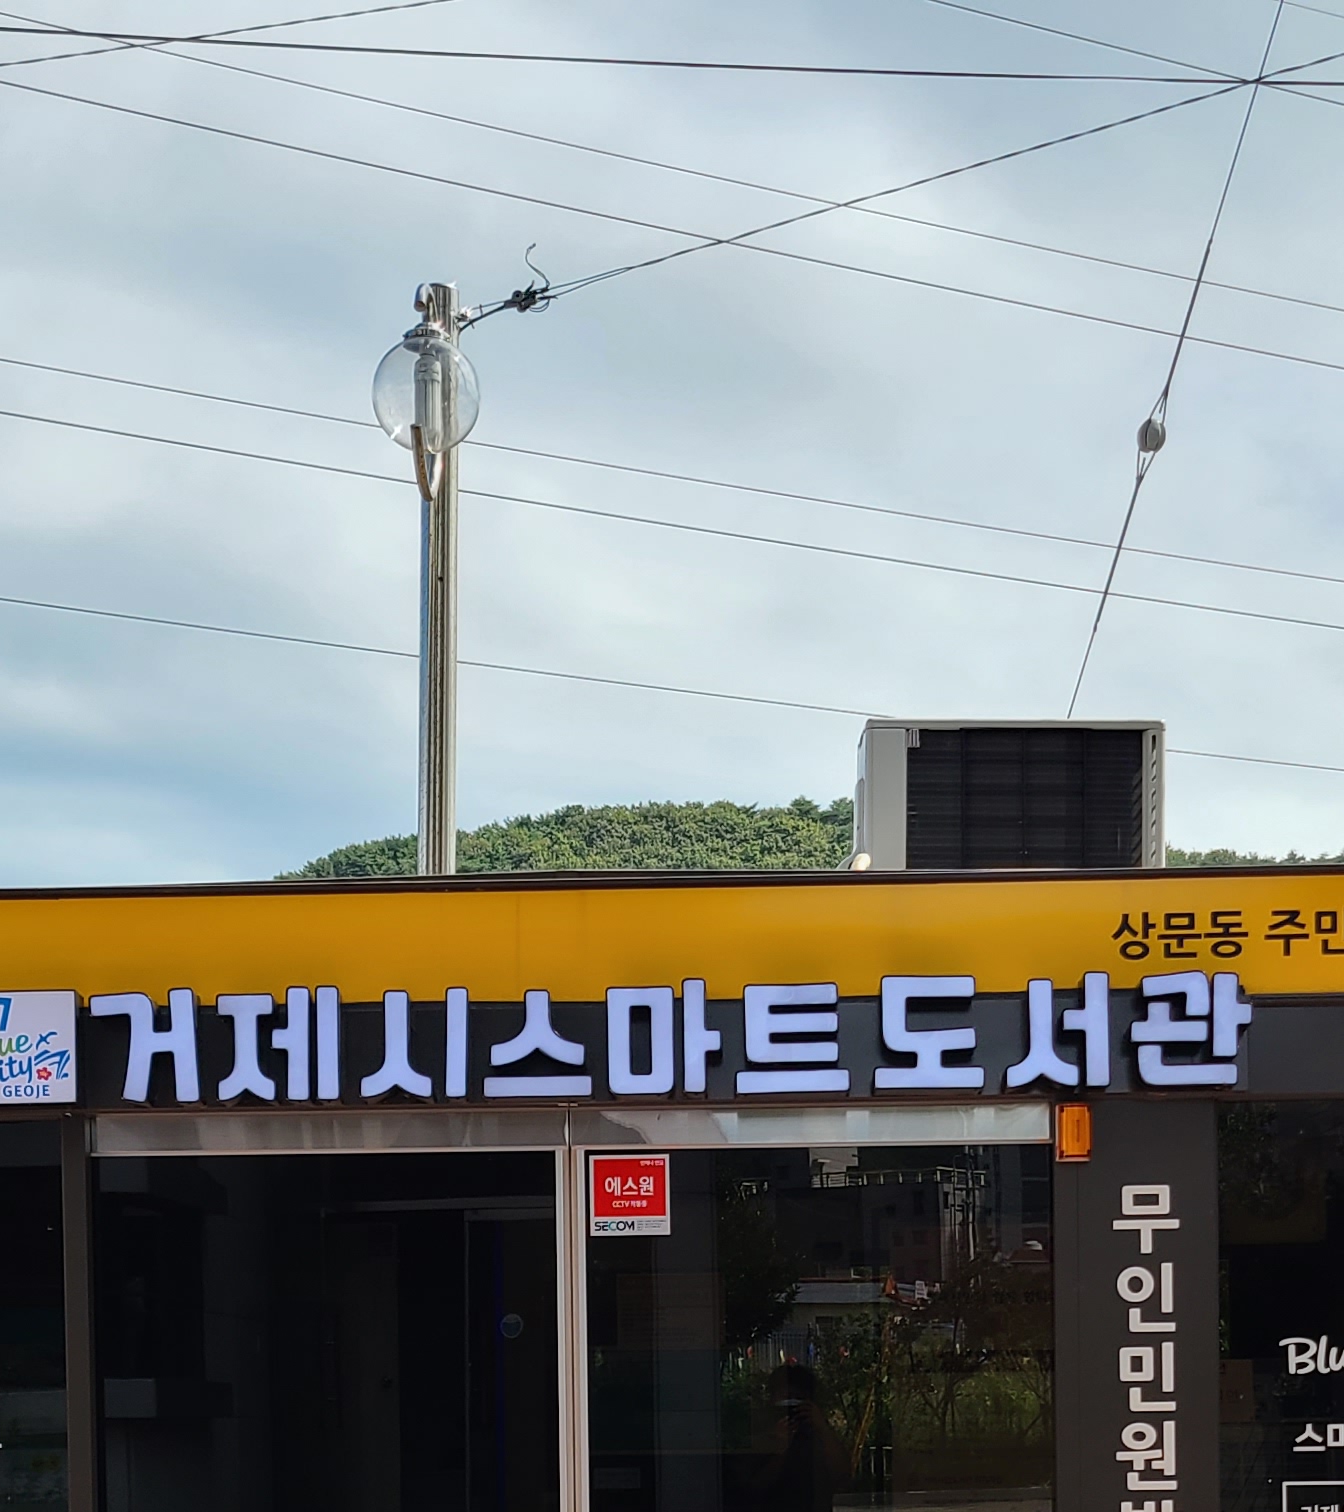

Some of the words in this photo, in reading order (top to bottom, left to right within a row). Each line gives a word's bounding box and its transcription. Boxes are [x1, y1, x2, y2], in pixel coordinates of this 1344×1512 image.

[1112, 910, 1249, 961] 상문동
[88, 970, 1253, 1101] 거제시스마트도서관
[2, 1085, 51, 1099] GEOJE
[604, 1176, 654, 1197] 에스원
[594, 1221, 635, 1231] SECOM
